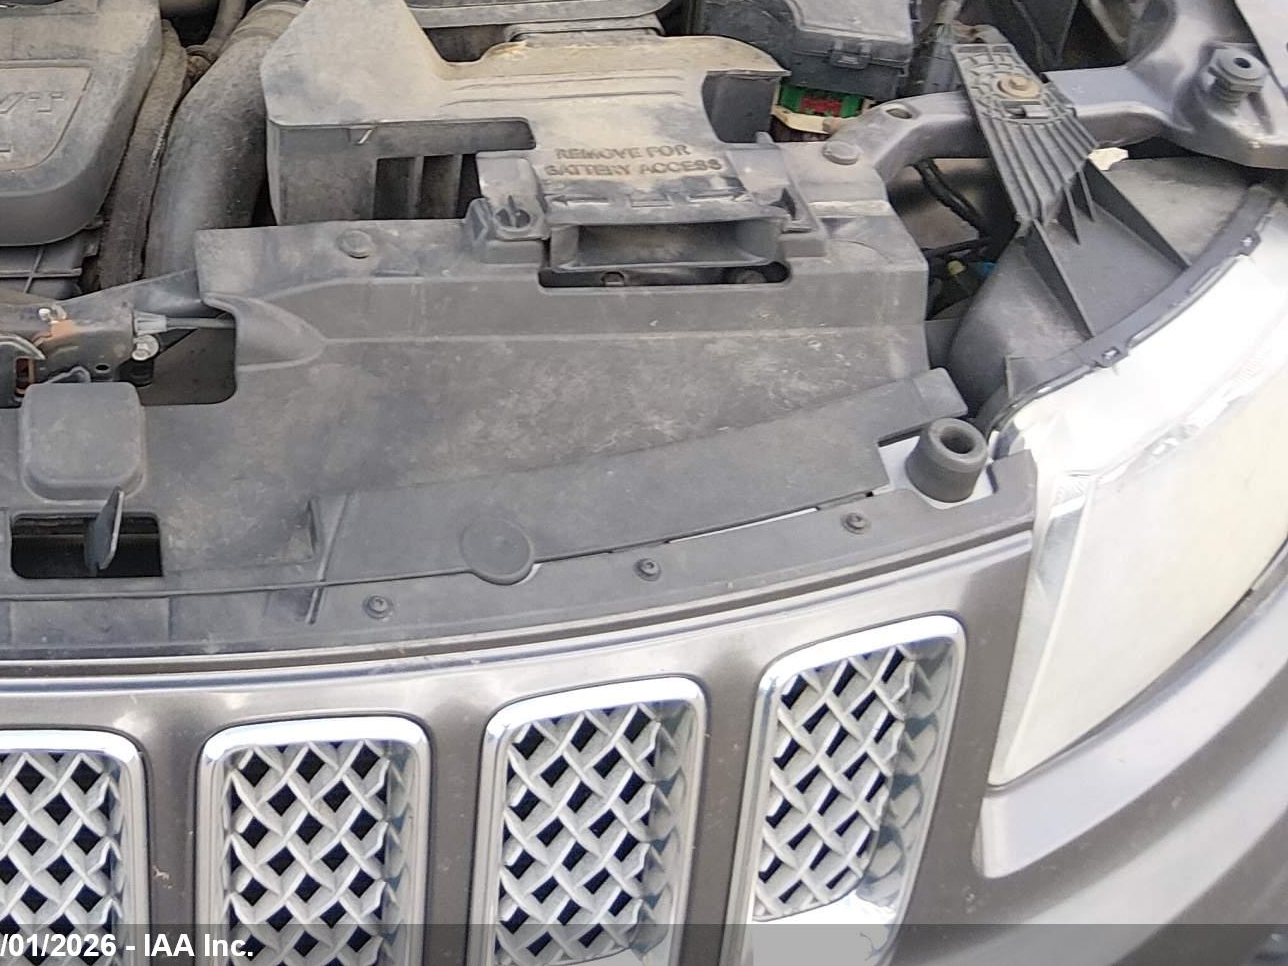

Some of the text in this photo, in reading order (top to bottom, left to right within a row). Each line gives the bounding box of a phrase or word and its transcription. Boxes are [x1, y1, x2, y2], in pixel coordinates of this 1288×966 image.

[556, 144, 692, 160] REMOVE FOR
[639, 158, 724, 175] ACCESS
